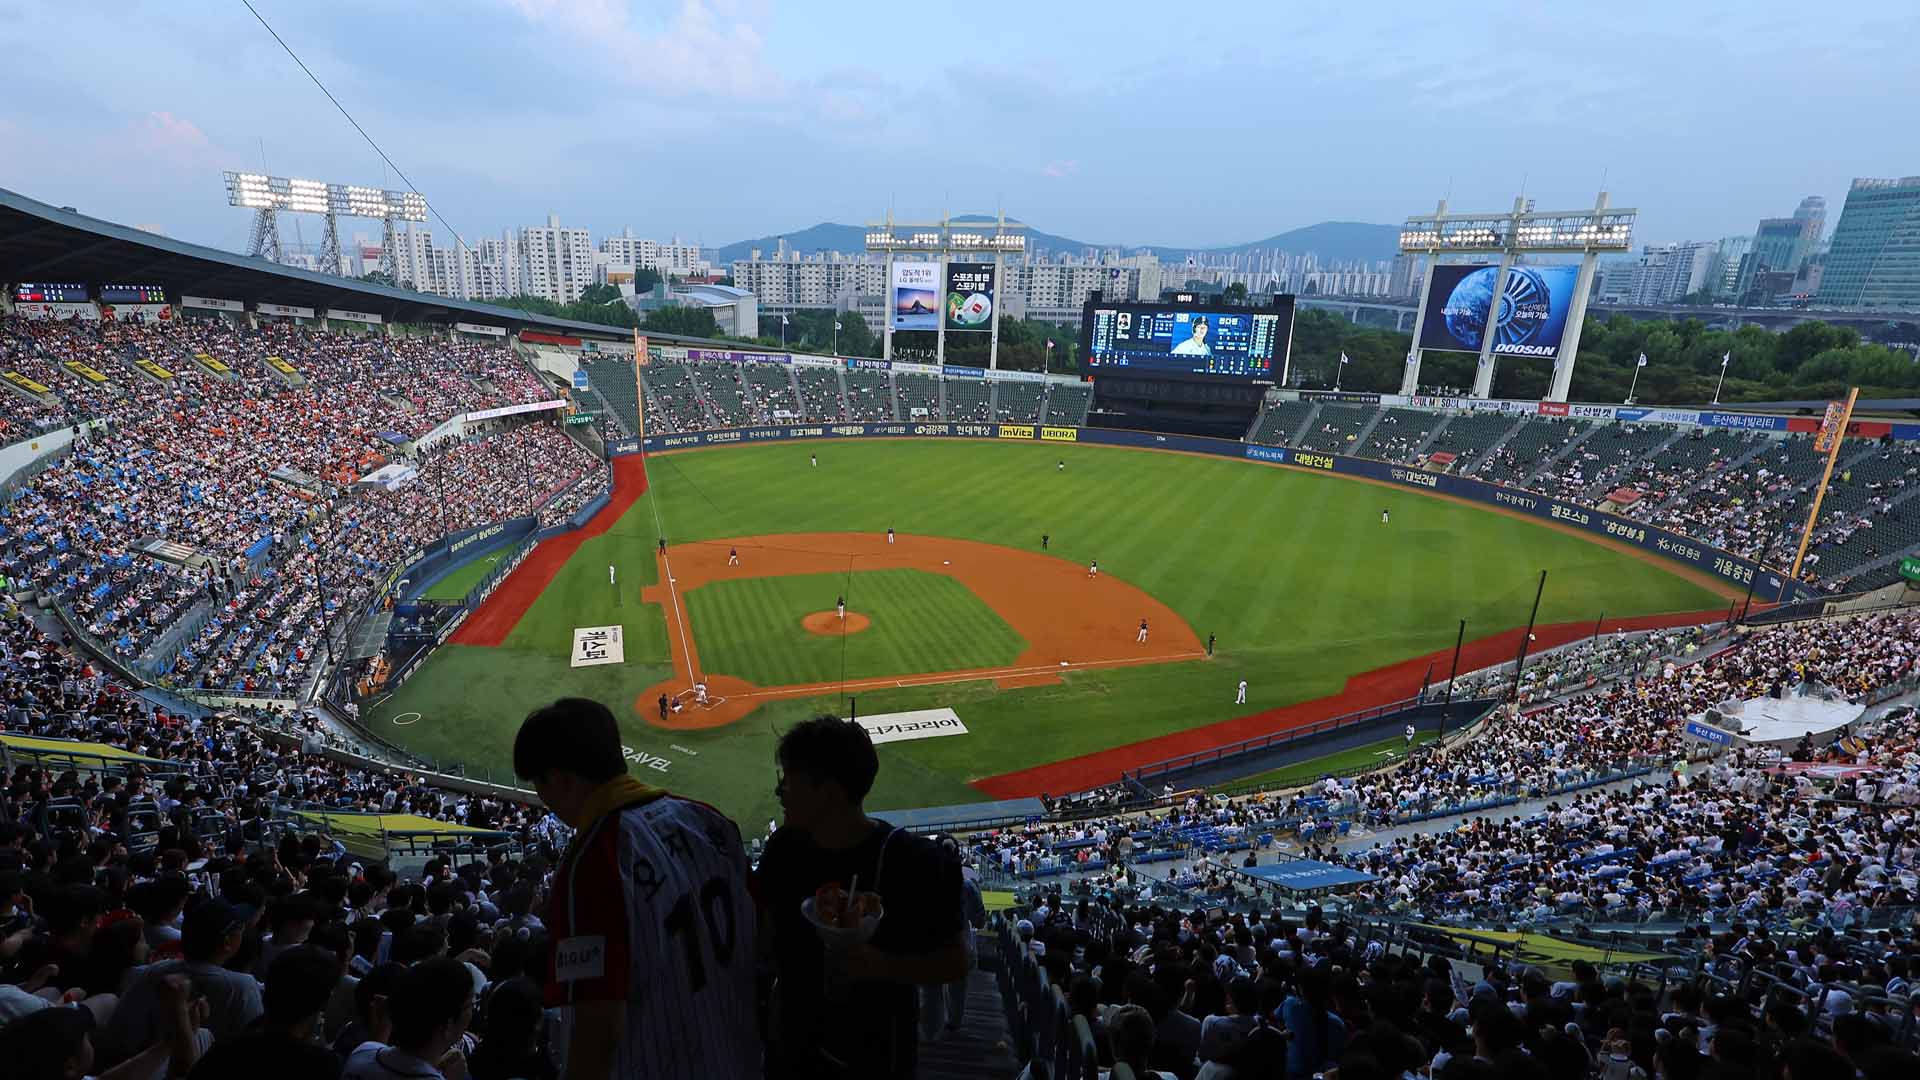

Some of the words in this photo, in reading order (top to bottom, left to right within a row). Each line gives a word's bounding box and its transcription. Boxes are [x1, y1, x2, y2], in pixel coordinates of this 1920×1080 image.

[952, 273, 974, 282] 스포츠
[955, 282, 977, 291] 스포키
[1515, 311, 1534, 319] 오늘의
[1495, 343, 1556, 356] DOOSAN
[1574, 406, 1612, 418] 두산밥캣
[1711, 414, 1775, 428] 두산에너빌리티
[1042, 428, 1075, 439] UBORA
[1294, 453, 1334, 469] 대방건설
[1405, 471, 1438, 488] 대보건설
[1496, 491, 1537, 510] 한국경제TV
[1671, 543, 1701, 561] KB증권
[1713, 558, 1754, 584] 키움증권
[578, 631, 609, 661] 캐스퍼
[866, 718, 958, 735] 디카코리아
[1695, 726, 1709, 737] 두산
[621, 744, 672, 773] RAVEL
[664, 876, 739, 993] 10
